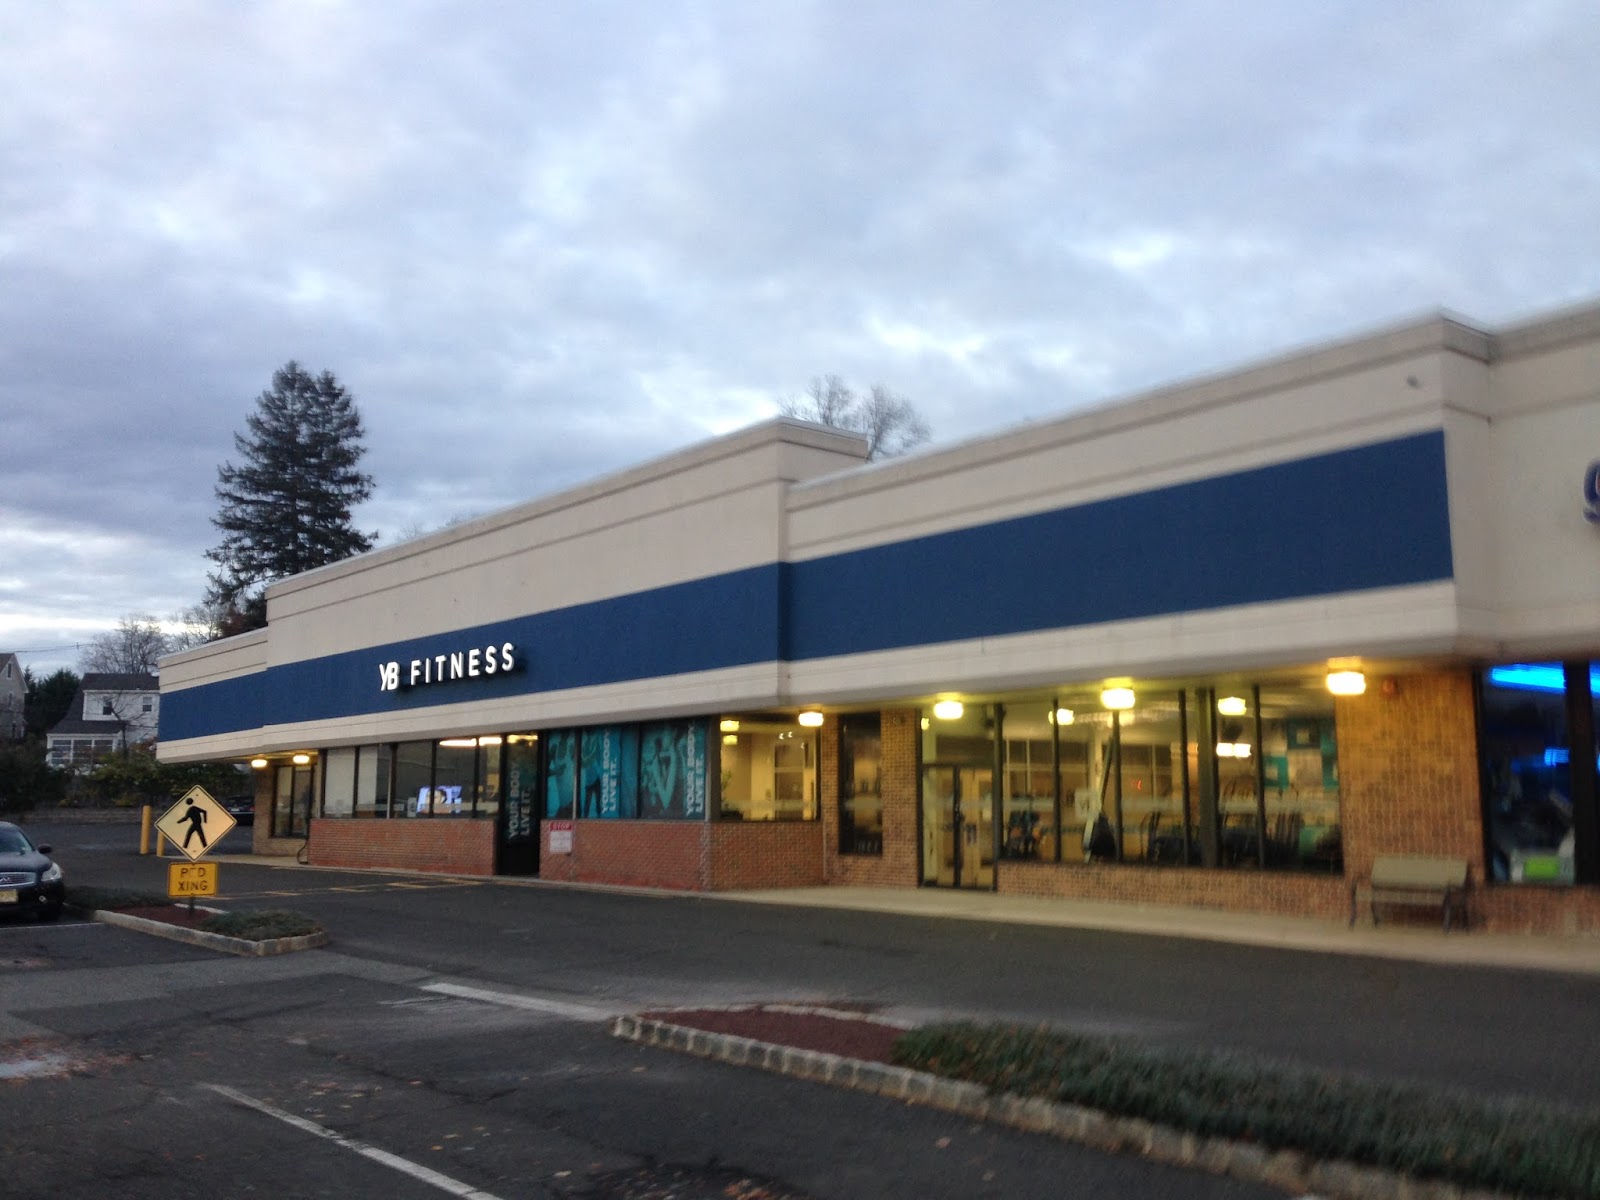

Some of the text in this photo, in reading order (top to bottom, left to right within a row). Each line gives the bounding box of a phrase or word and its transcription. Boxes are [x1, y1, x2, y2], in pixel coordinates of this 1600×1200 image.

[411, 642, 514, 686] FITNESS
[508, 801, 519, 839] YOUR
[520, 806, 530, 836] LIVE
[178, 880, 208, 892] XING
[180, 867, 206, 878] PD
